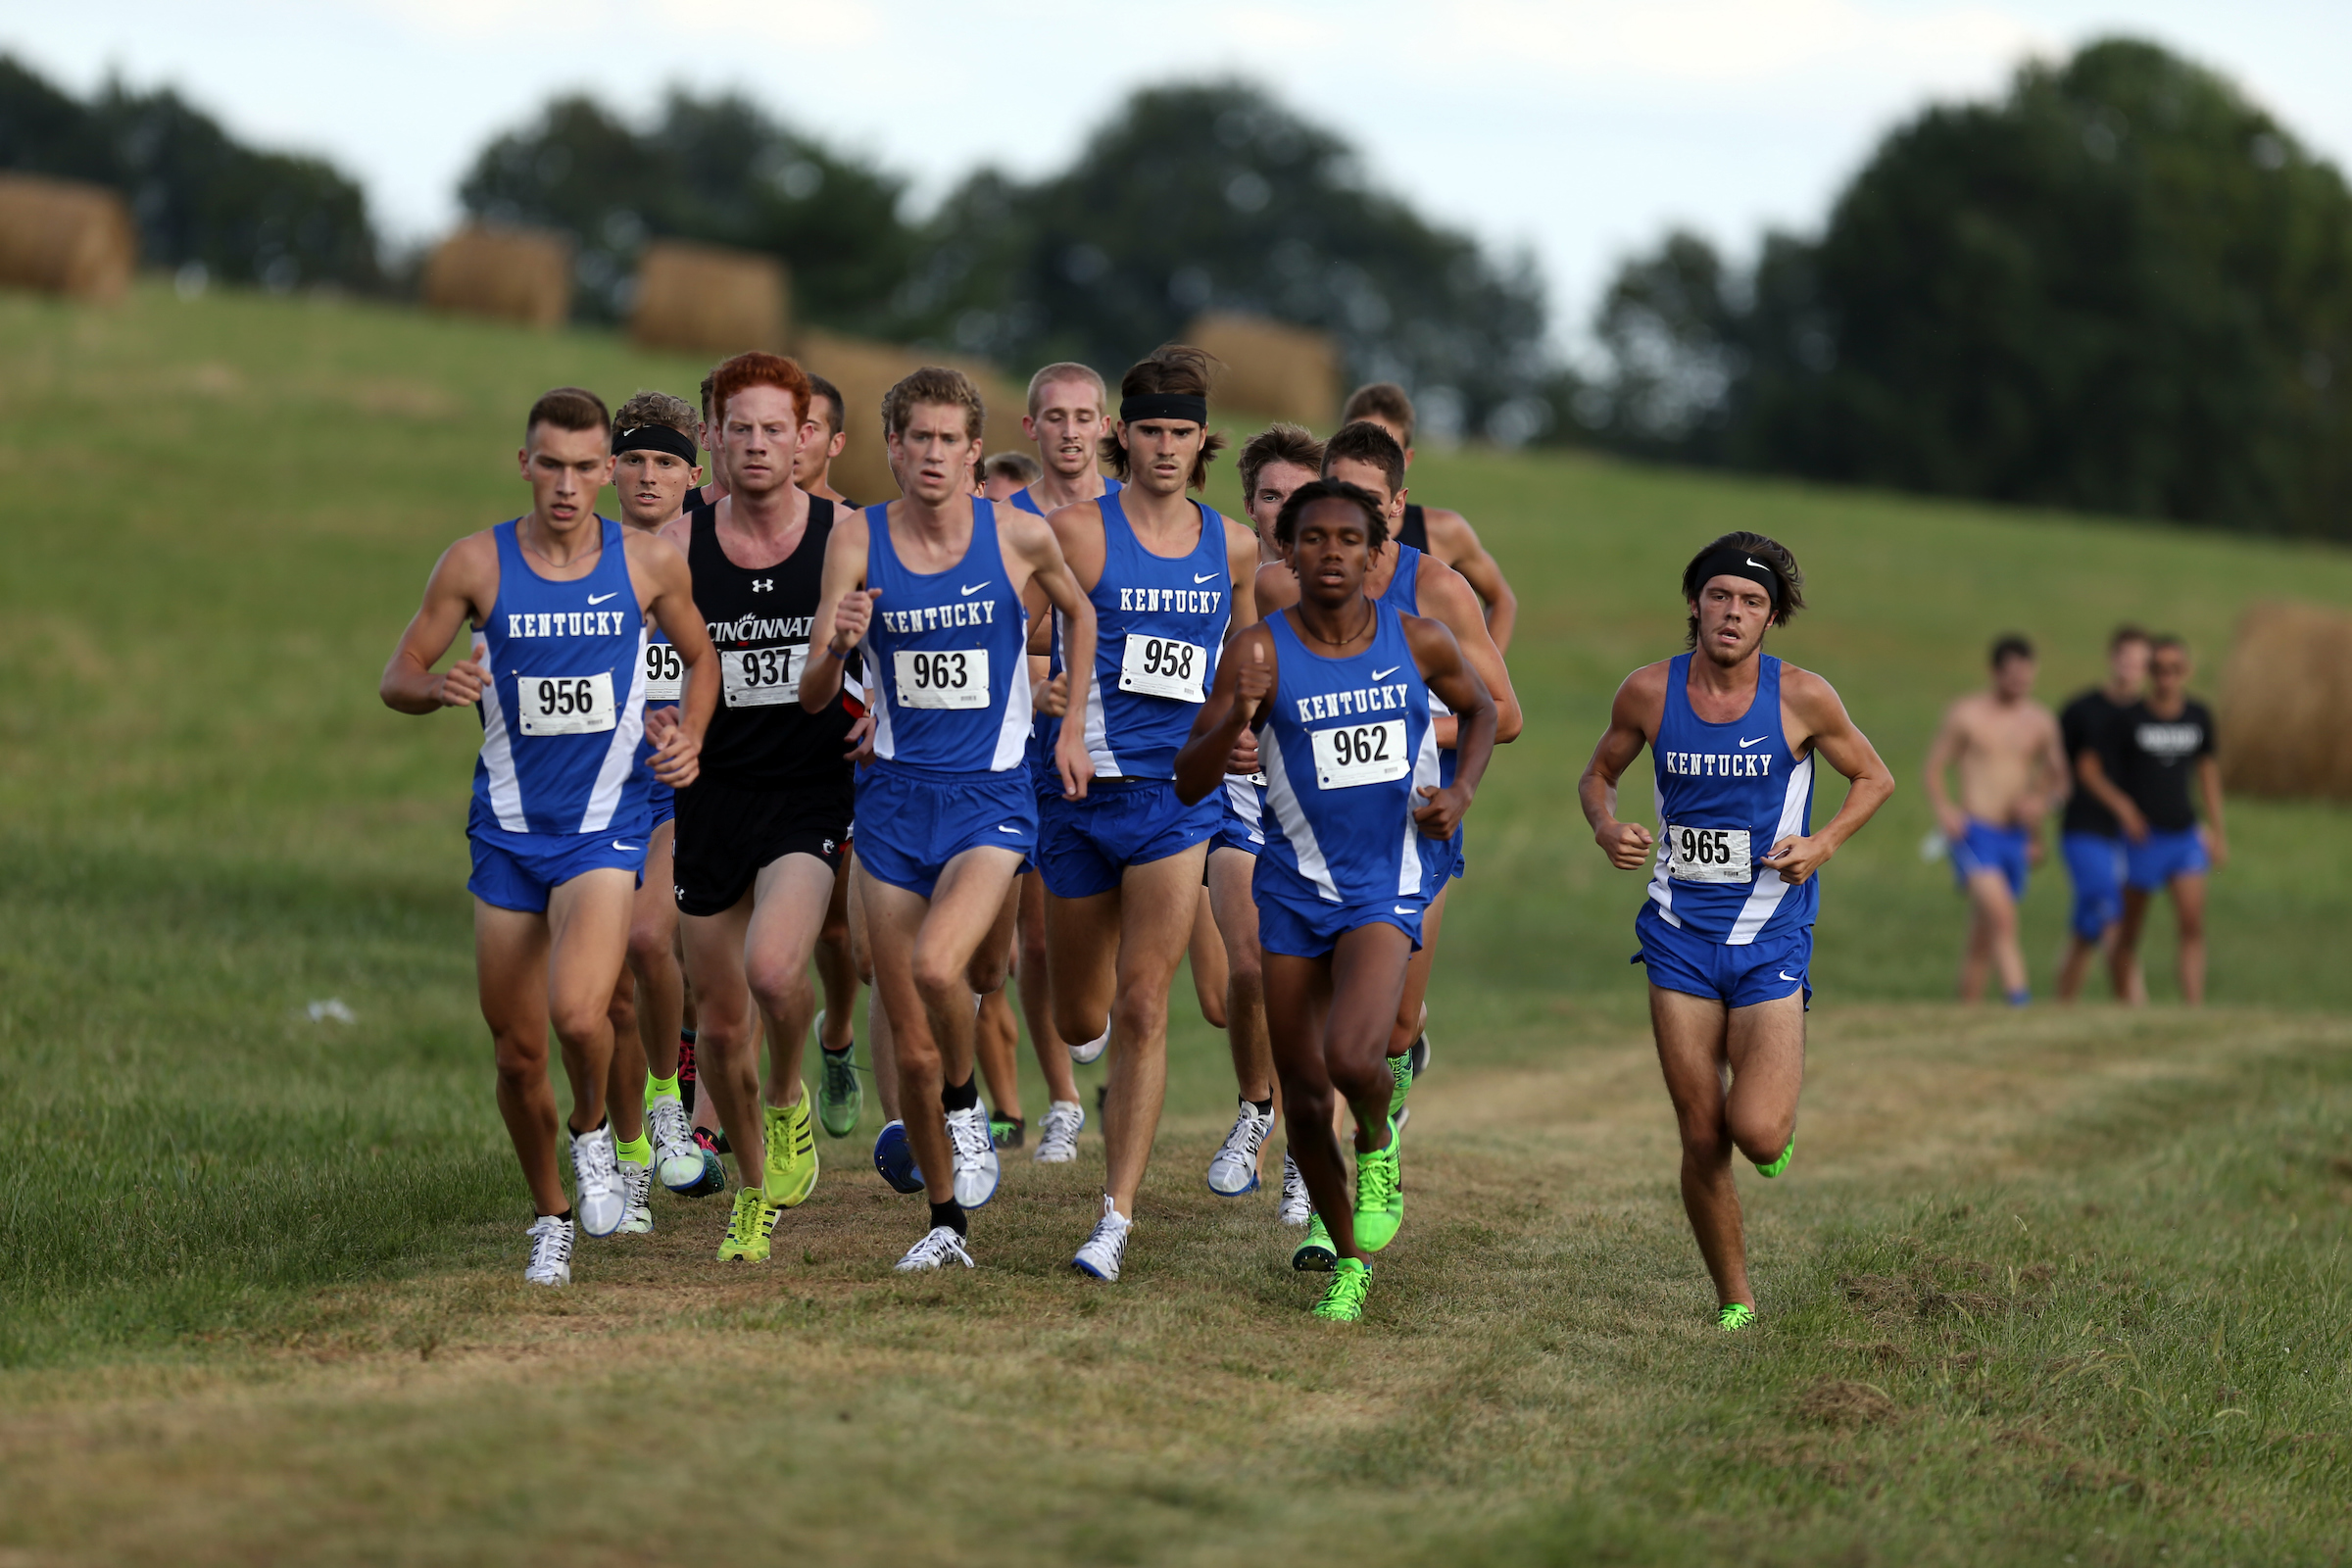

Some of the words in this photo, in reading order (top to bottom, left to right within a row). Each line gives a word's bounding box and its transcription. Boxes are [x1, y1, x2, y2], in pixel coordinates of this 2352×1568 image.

[882, 600, 995, 633] KENTUCKY
[1120, 588, 1221, 613] KENTUCKY
[509, 612, 624, 638] KENTUCKY
[707, 616, 815, 642] CINCINNAT
[646, 645, 684, 680] 95
[742, 648, 791, 686] 937
[913, 653, 967, 689] 963
[1144, 639, 1193, 680] 958
[538, 679, 593, 715] 956
[1297, 683, 1407, 722] KENTUCKY
[1334, 725, 1389, 766] 962
[1666, 751, 1772, 776] KENTUCKY
[1682, 828, 1730, 864] 965
